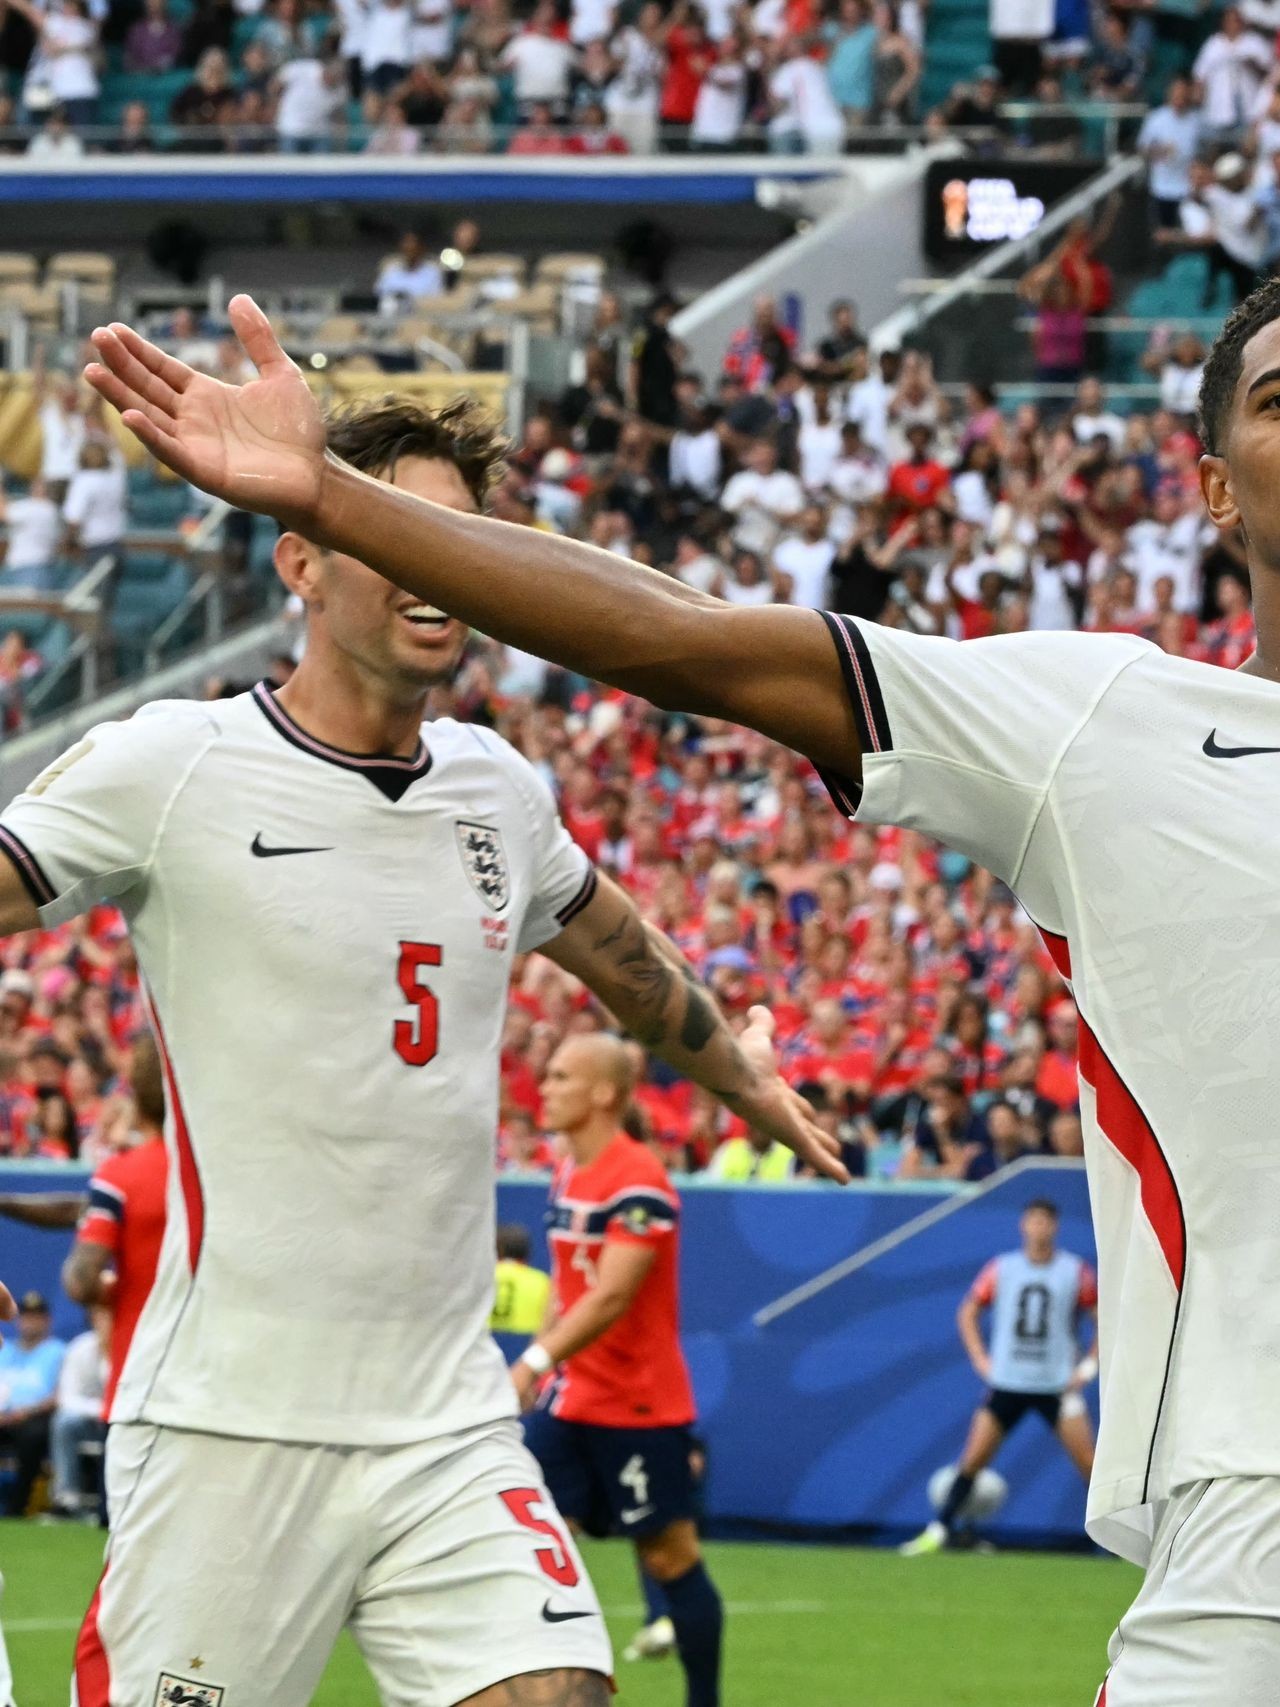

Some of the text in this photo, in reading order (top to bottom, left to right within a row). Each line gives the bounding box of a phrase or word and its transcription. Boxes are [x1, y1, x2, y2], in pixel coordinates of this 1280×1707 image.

[393, 940, 443, 1067] 5
[618, 1454, 649, 1504] 4
[498, 1487, 579, 1587] 5
